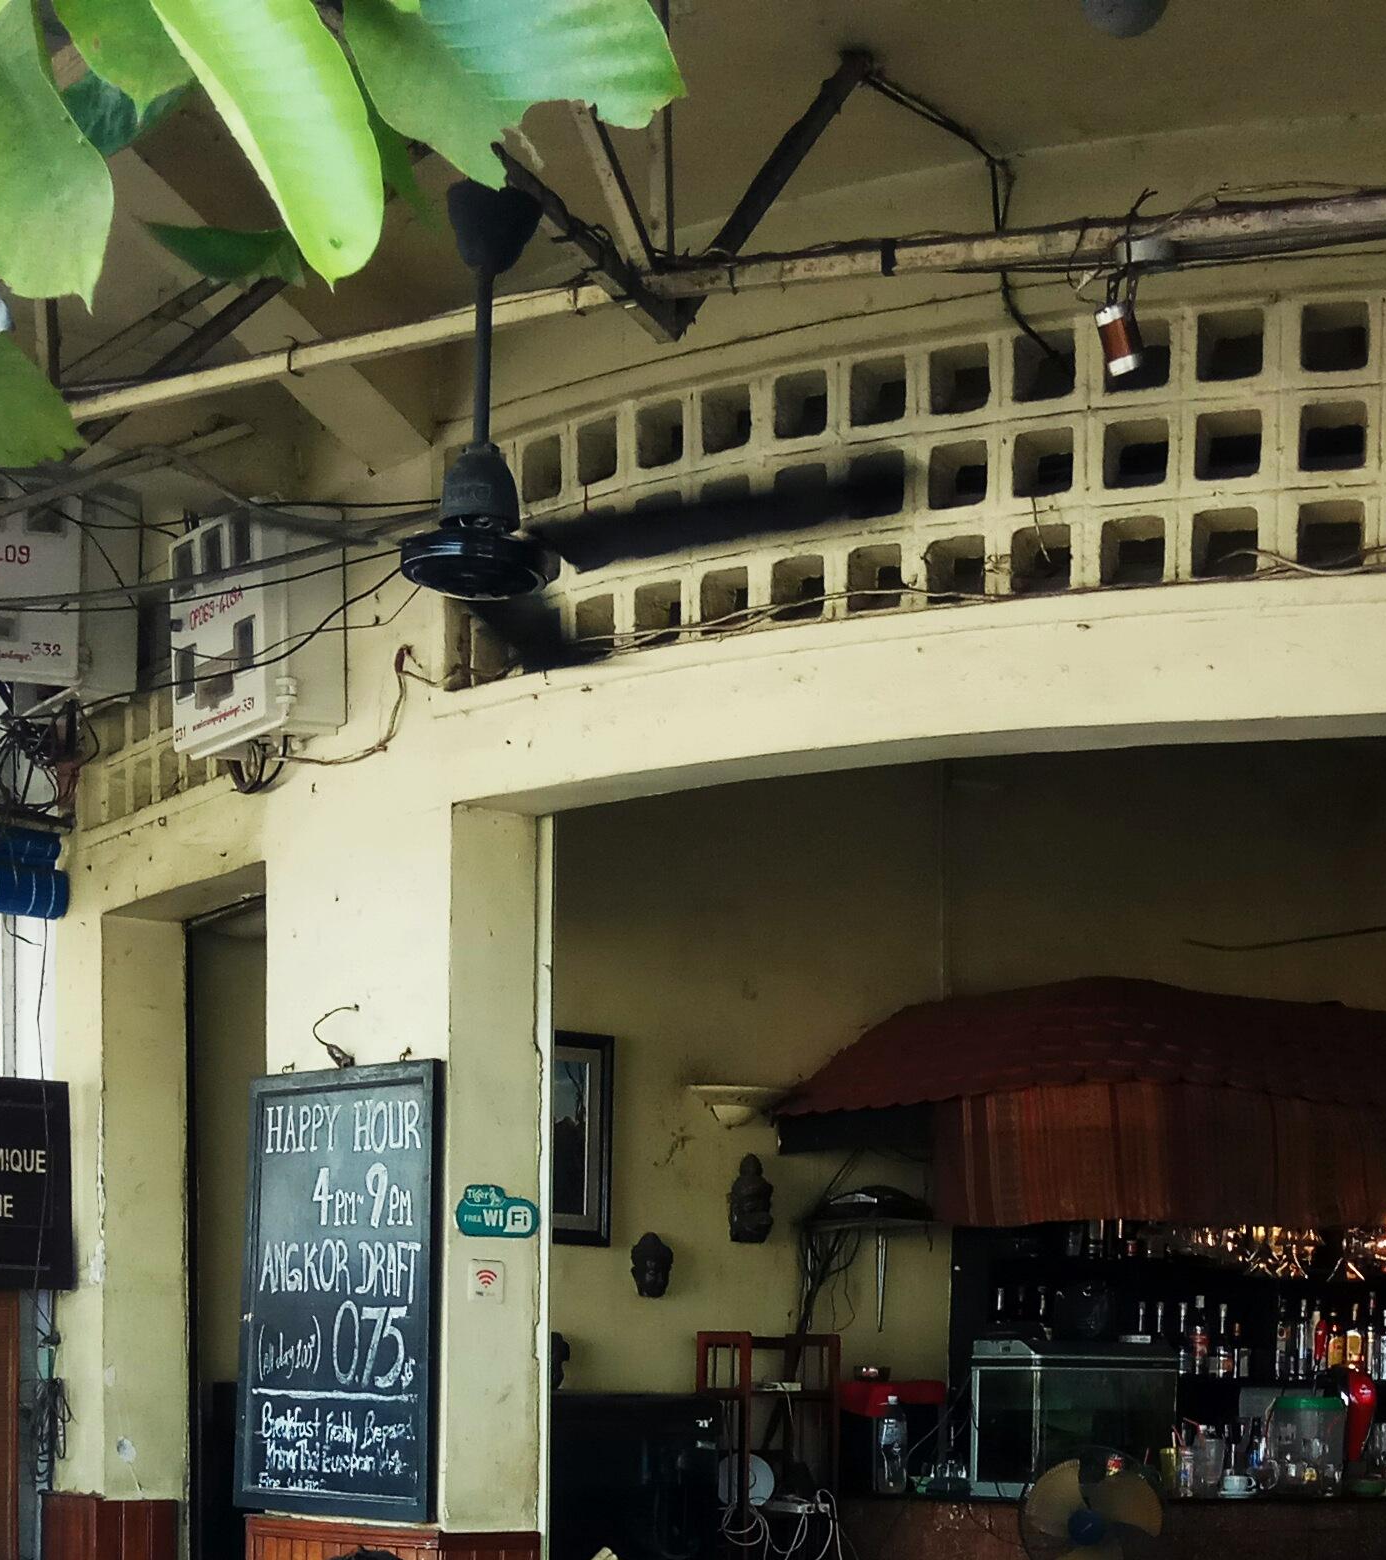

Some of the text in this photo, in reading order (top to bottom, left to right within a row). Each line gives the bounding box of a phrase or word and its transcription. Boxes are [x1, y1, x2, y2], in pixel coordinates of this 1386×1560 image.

[265, 1099, 422, 1154] HAPPY HOUR
[259, 1238, 422, 1304] ANGKOR DRAFT
